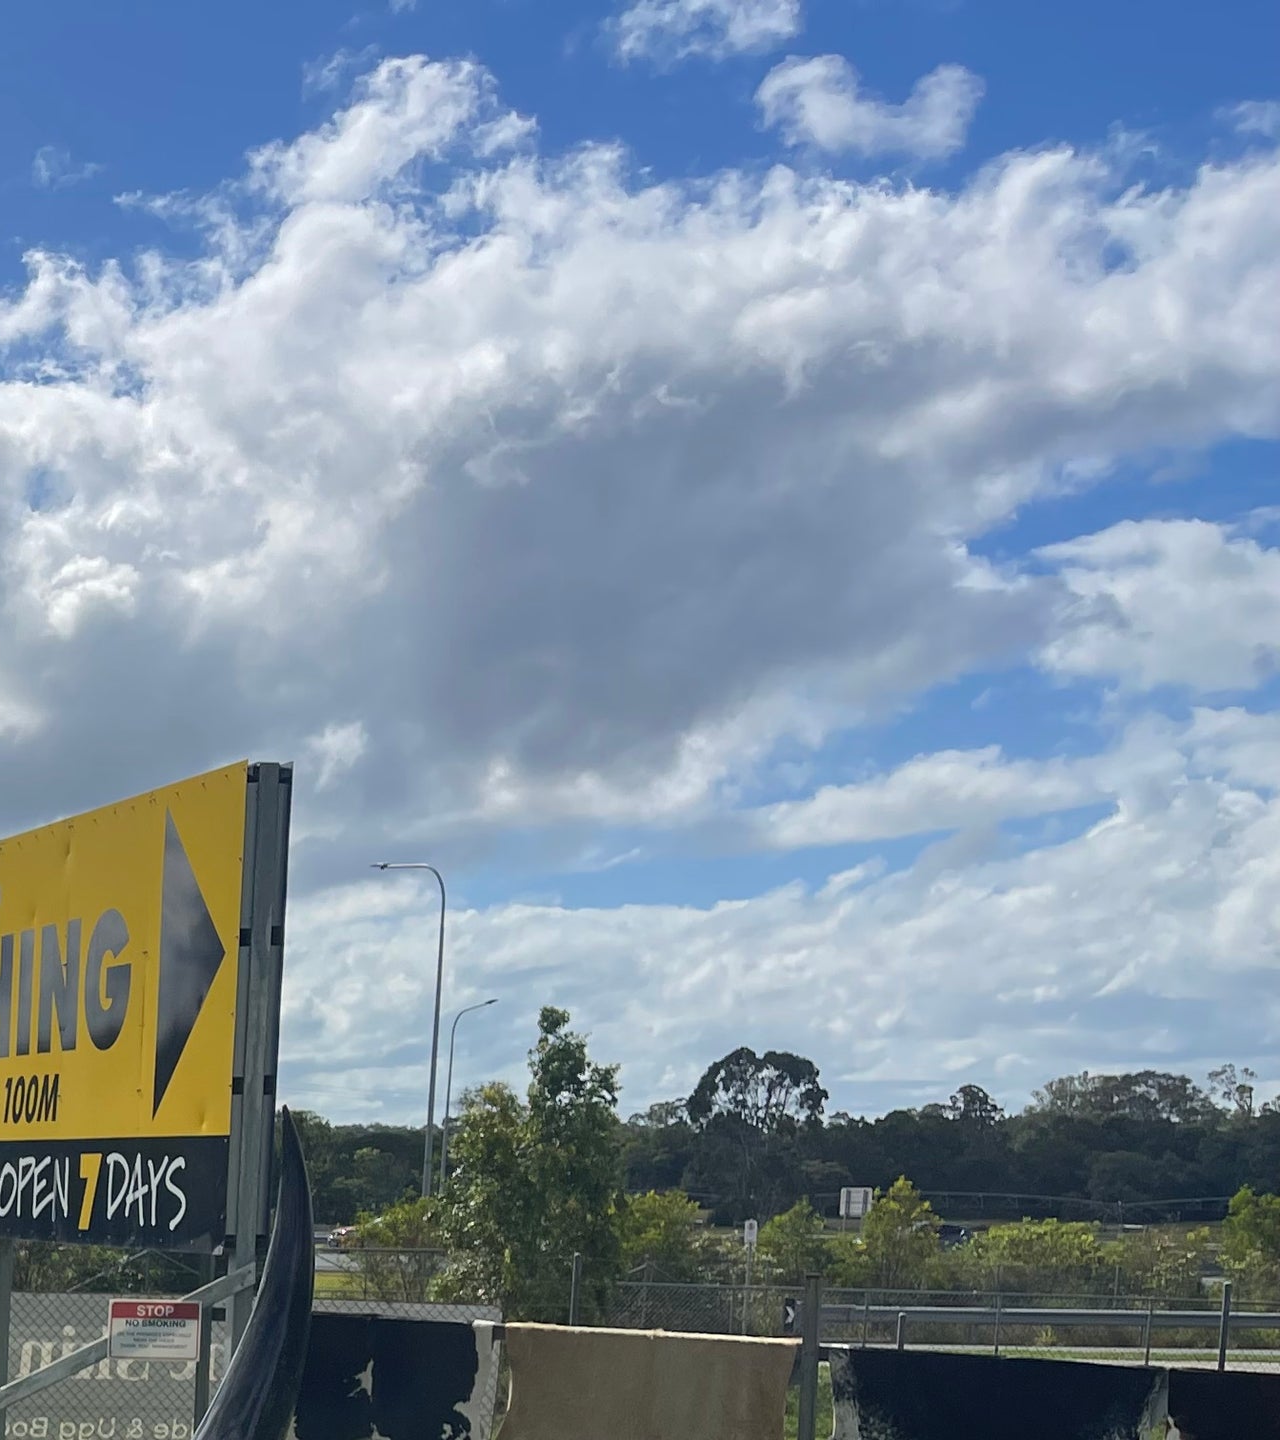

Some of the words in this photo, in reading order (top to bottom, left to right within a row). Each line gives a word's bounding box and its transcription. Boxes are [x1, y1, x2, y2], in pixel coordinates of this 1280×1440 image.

[3, 1073, 60, 1124] 100M
[78, 1152, 103, 1231] 7
[106, 1152, 186, 1231] DAYS
[125, 1319, 140, 1328] NO
[142, 1319, 187, 1328] SMOKING
[136, 1304, 174, 1317] STOP
